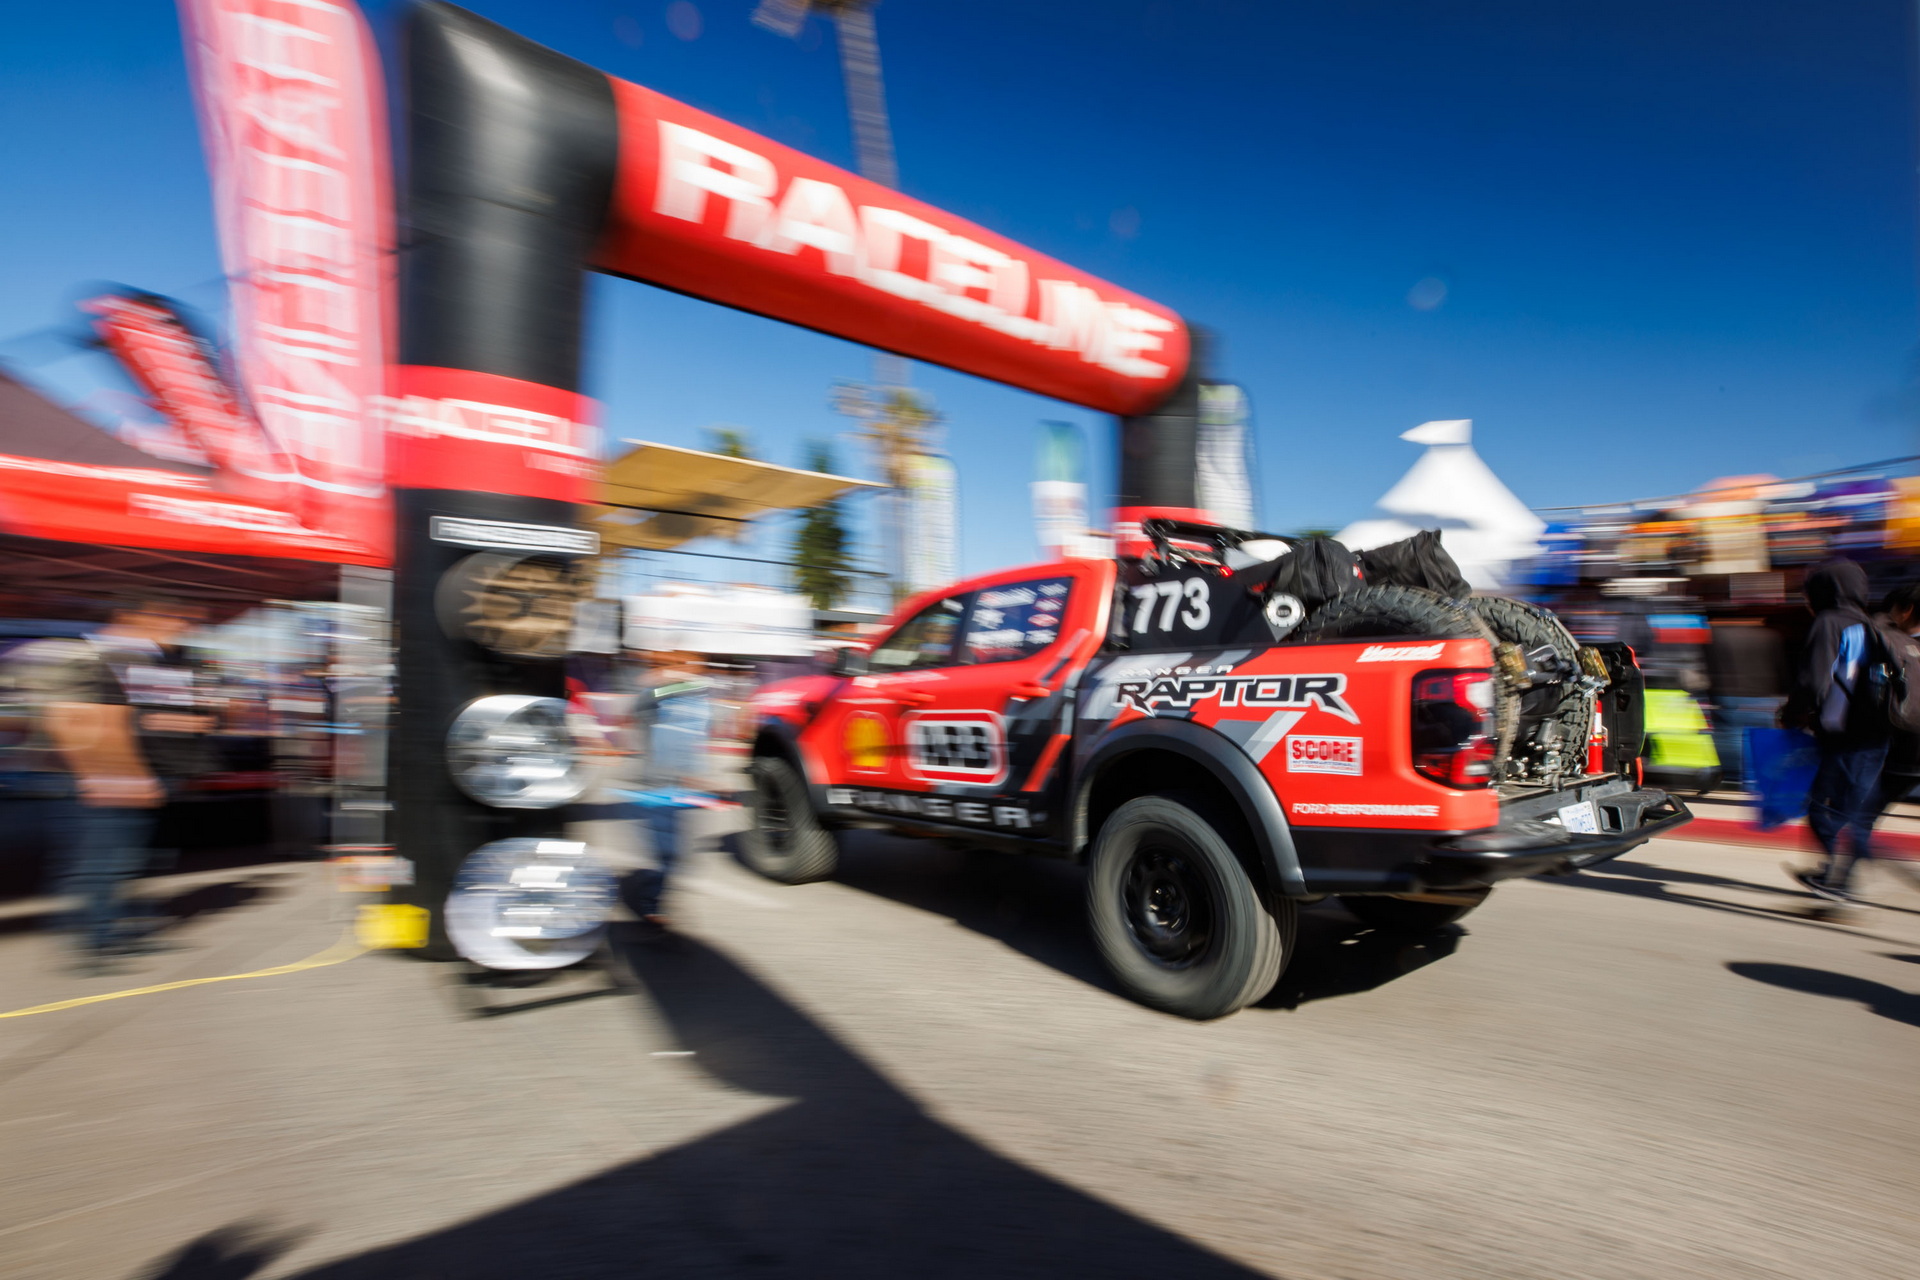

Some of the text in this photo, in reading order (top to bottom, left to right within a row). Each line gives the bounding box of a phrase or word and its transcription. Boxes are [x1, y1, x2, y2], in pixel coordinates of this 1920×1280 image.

[653, 119, 1176, 380] RACELINE
[1131, 577, 1211, 634] 773
[1118, 665, 1234, 677] RANGER
[1111, 674, 1360, 725] RAPTOR
[1292, 740, 1358, 763] SCORE
[1291, 803, 1440, 817] FORD PERFORMANCE
